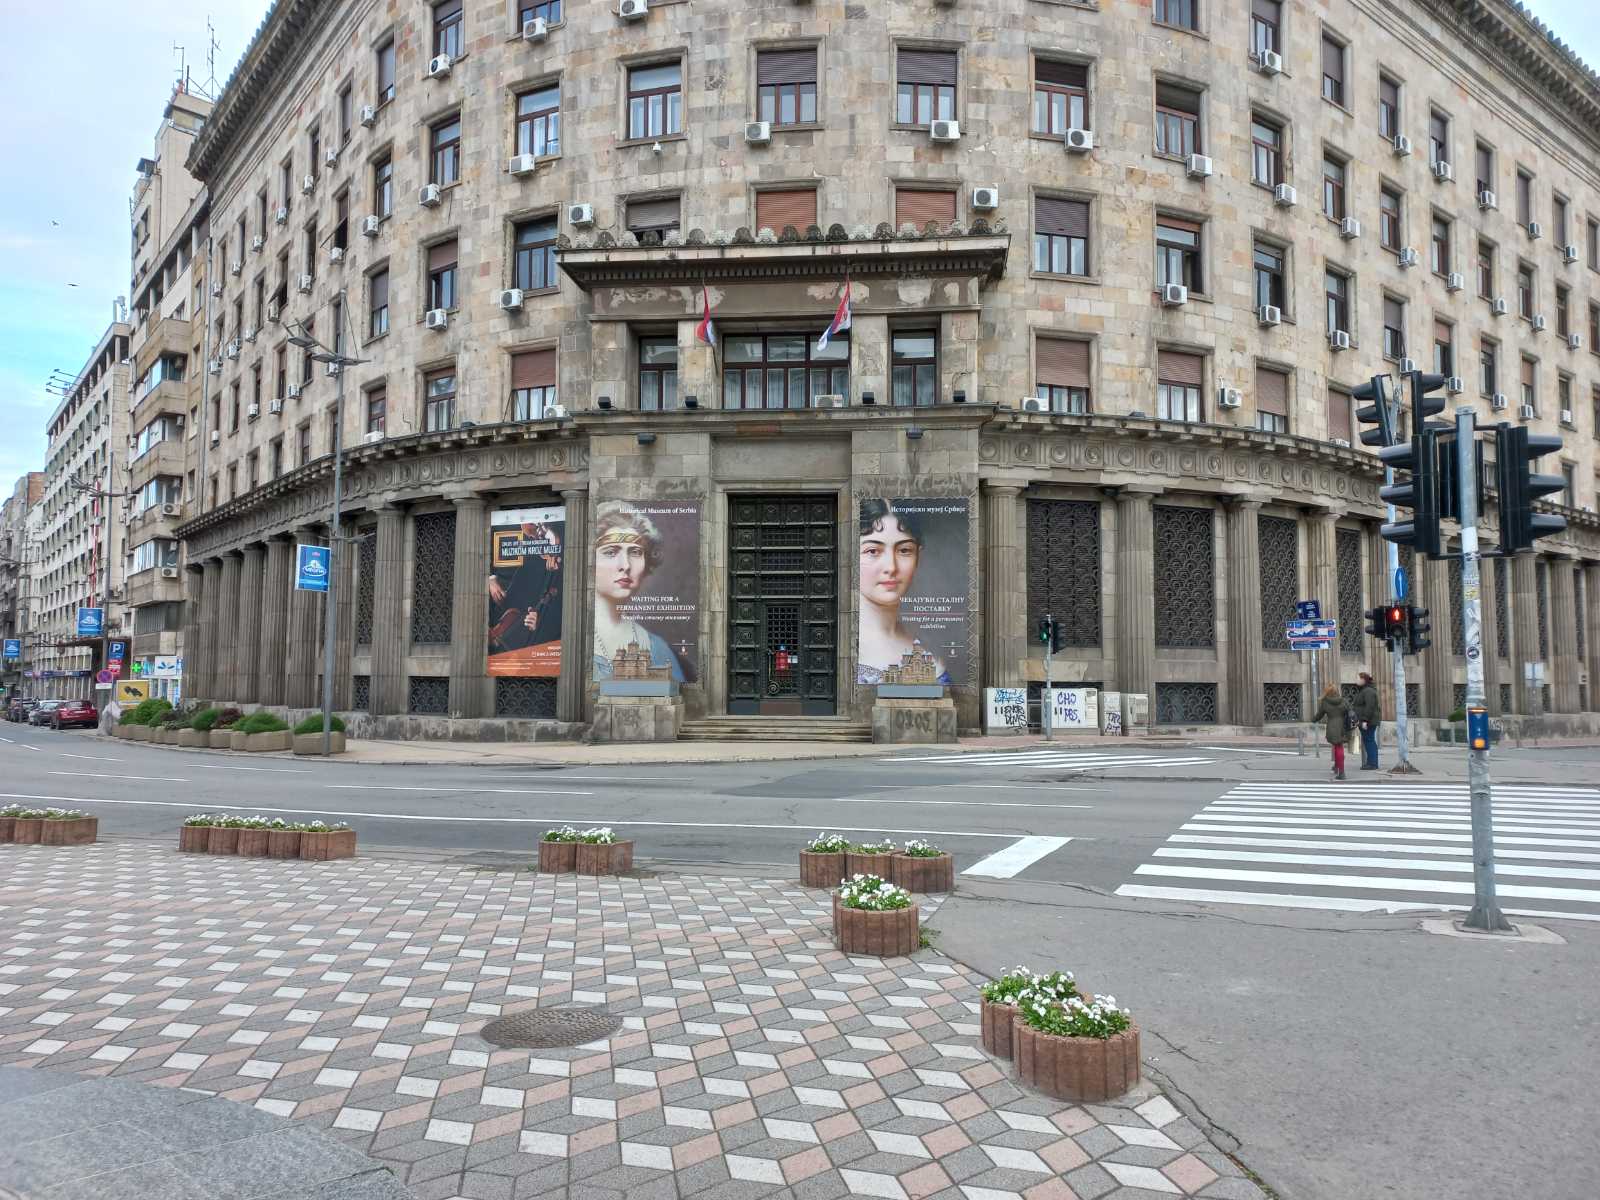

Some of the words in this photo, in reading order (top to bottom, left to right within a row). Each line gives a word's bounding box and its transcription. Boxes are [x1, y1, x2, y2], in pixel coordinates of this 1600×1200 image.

[647, 506, 671, 514] Museum
[671, 506, 679, 514] of
[679, 506, 697, 514] Serbia
[890, 506, 926, 514] Историјски
[944, 505, 966, 514] Србије
[527, 546, 542, 555] KROZ
[543, 545, 562, 554] MUZEJ
[112, 643, 121, 653] P
